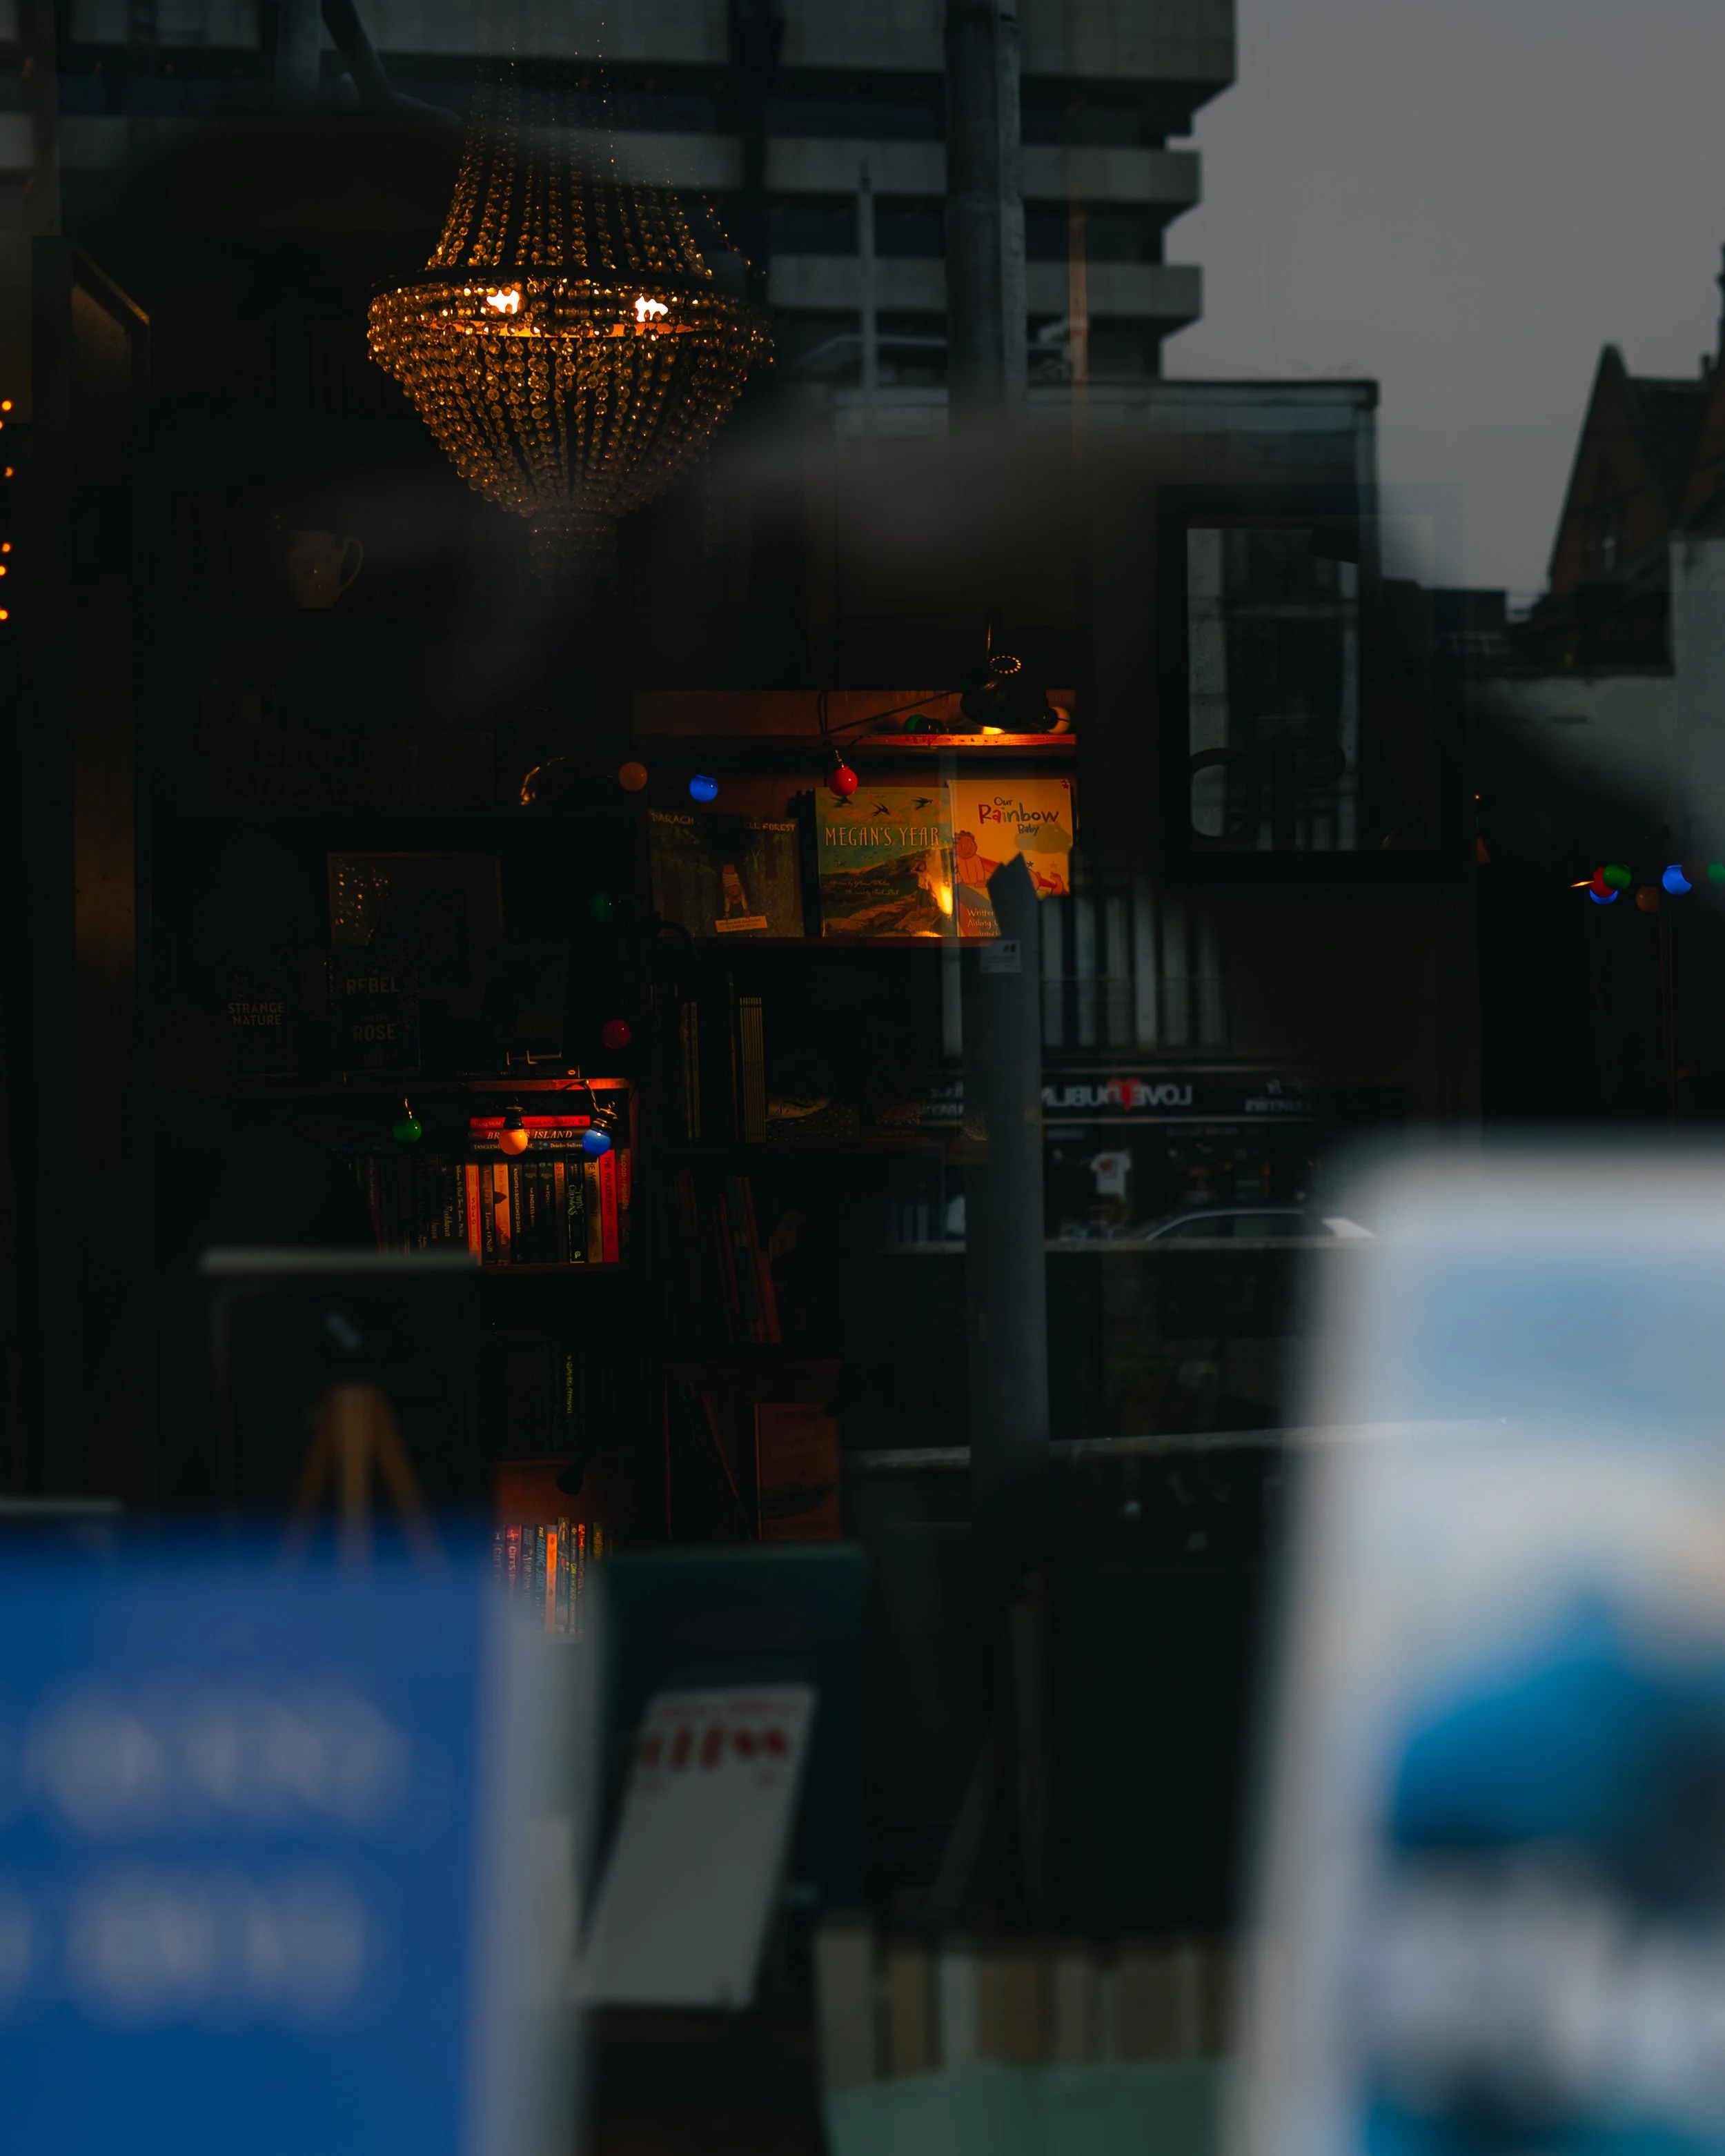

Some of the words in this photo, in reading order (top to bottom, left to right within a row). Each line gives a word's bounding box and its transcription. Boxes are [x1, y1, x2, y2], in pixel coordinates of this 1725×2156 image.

[994, 796, 1014, 807] Our
[651, 813, 695, 825] DARACH
[978, 802, 1060, 824] Rainbow
[762, 822, 796, 832] FOREST
[1017, 824, 1040, 836] Baby
[825, 827, 892, 847] MEGAN'S
[899, 827, 940, 847] YEAR
[967, 919, 992, 930] Aisling
[346, 976, 401, 995] REBEL
[227, 1002, 286, 1014] STRANGE
[232, 1014, 282, 1027] NATURE
[353, 1022, 397, 1042] ROSE
[533, 1130, 573, 1139] ISLAND
[588, 1161, 596, 1170] HE
[604, 1156, 612, 1169] THE
[566, 1185, 578, 1215] CROWNS
[575, 1189, 584, 1209] TWIN
